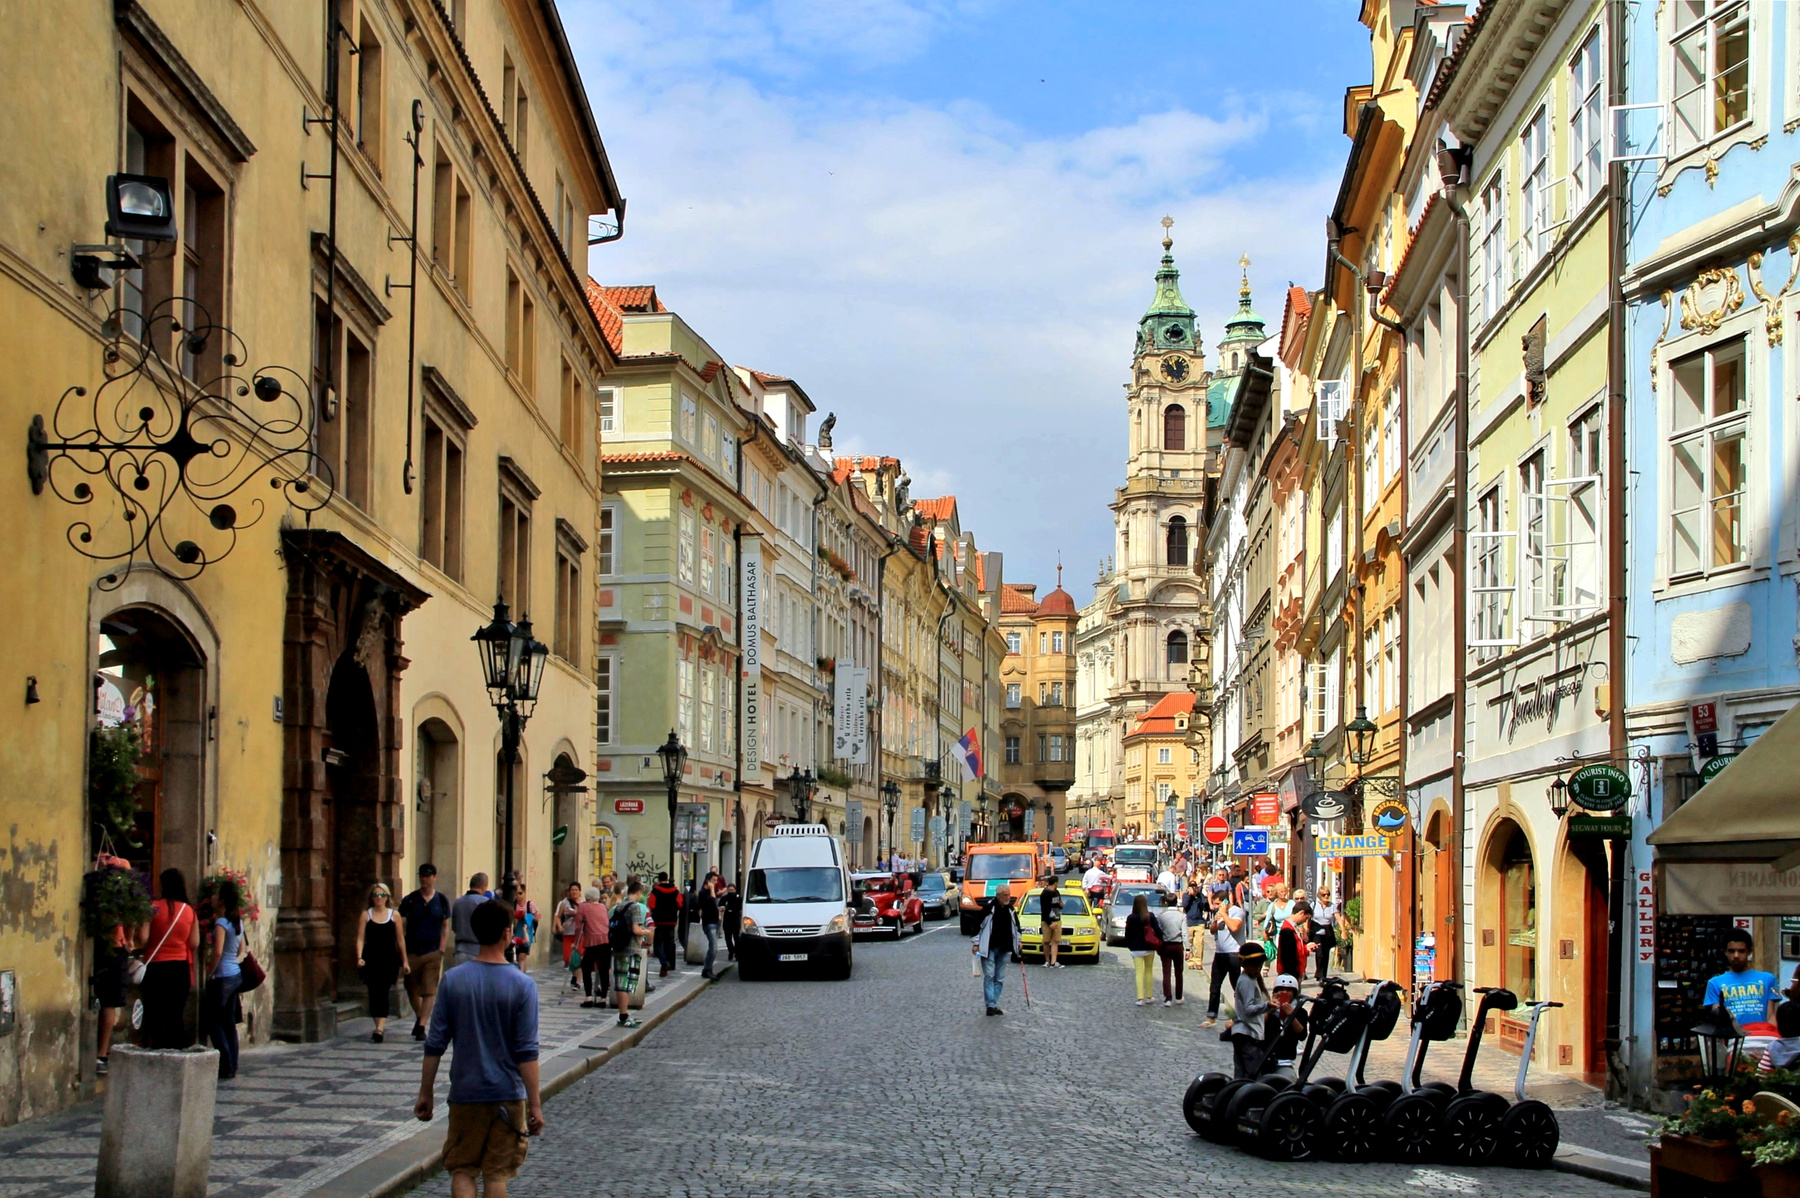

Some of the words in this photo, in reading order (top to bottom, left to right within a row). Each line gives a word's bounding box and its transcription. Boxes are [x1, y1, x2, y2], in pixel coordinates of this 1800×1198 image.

[747, 561, 757, 620] BALTHASAR
[747, 624, 757, 665] DOMUS
[747, 683, 757, 724] HOTEL
[1507, 674, 1557, 745] Jewellery
[1697, 705, 1710, 718] 53
[747, 729, 757, 771] DESIGN
[1575, 768, 1606, 782] TOURIST
[1607, 768, 1625, 783] INFO
[1570, 824, 1598, 832] SEGWAY
[1600, 824, 1622, 832] TOURS
[1318, 835, 1388, 850] CHANGE
[1333, 849, 1388, 857] COMMISSION
